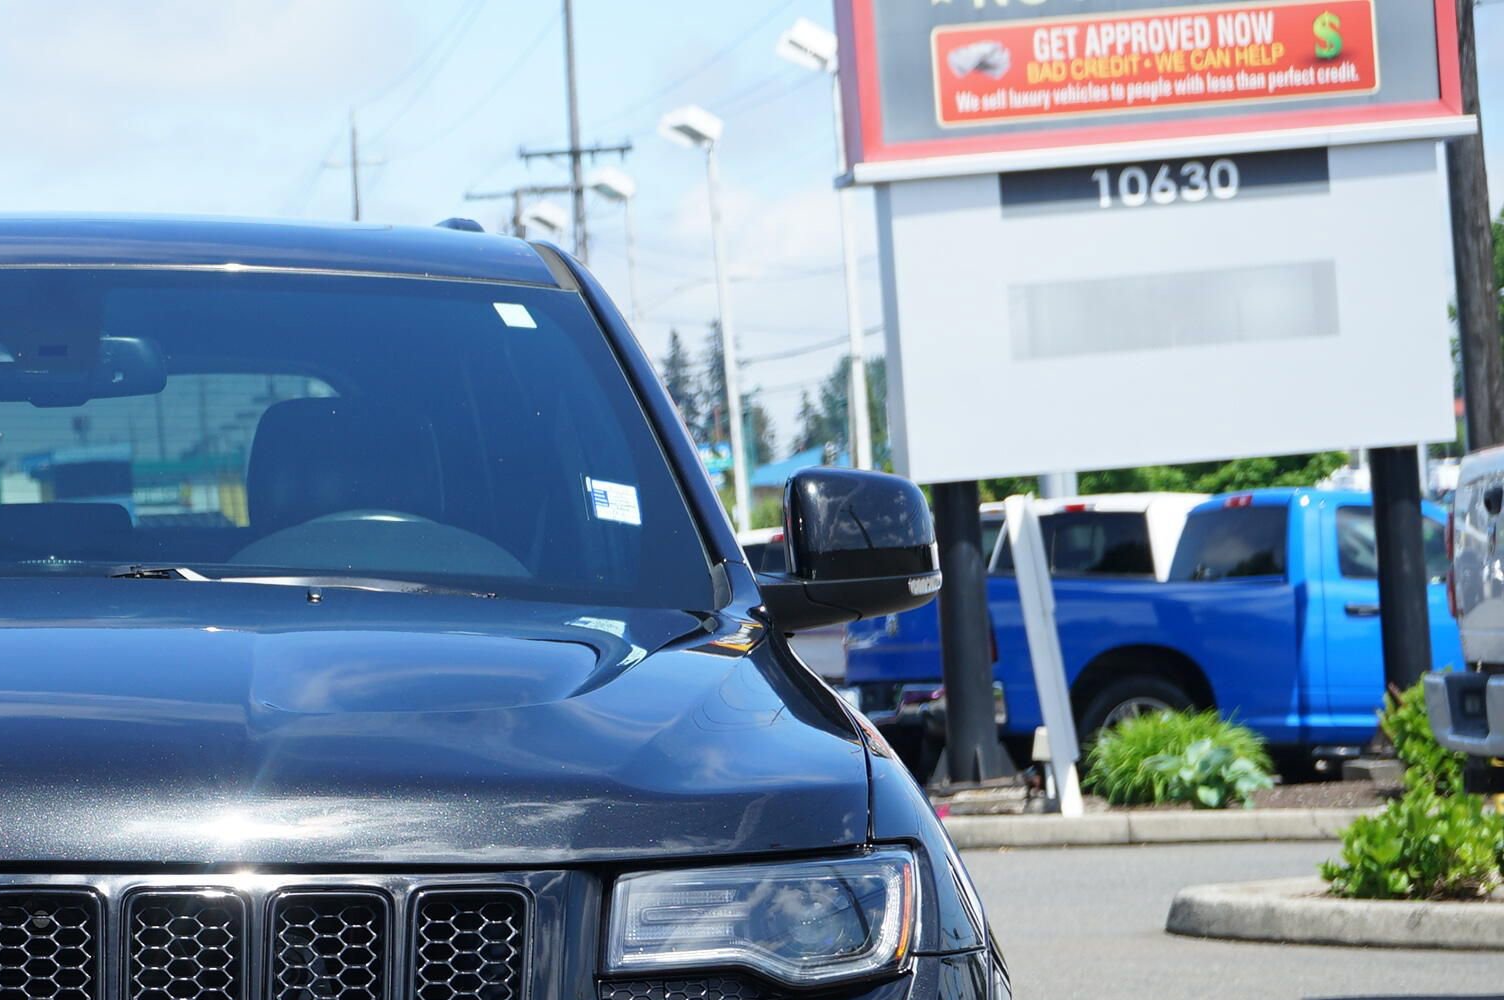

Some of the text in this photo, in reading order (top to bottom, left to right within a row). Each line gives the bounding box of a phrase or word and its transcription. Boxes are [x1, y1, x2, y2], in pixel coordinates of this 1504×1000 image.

[1033, 10, 1274, 62] GET APPROVED NOW
[955, 60, 1360, 113] We sell luxury vehicles to people with less than perfect credit.
[1027, 41, 1284, 84] BAD CREDIT WE CAN HELP
[1091, 159, 1239, 208] 10630
